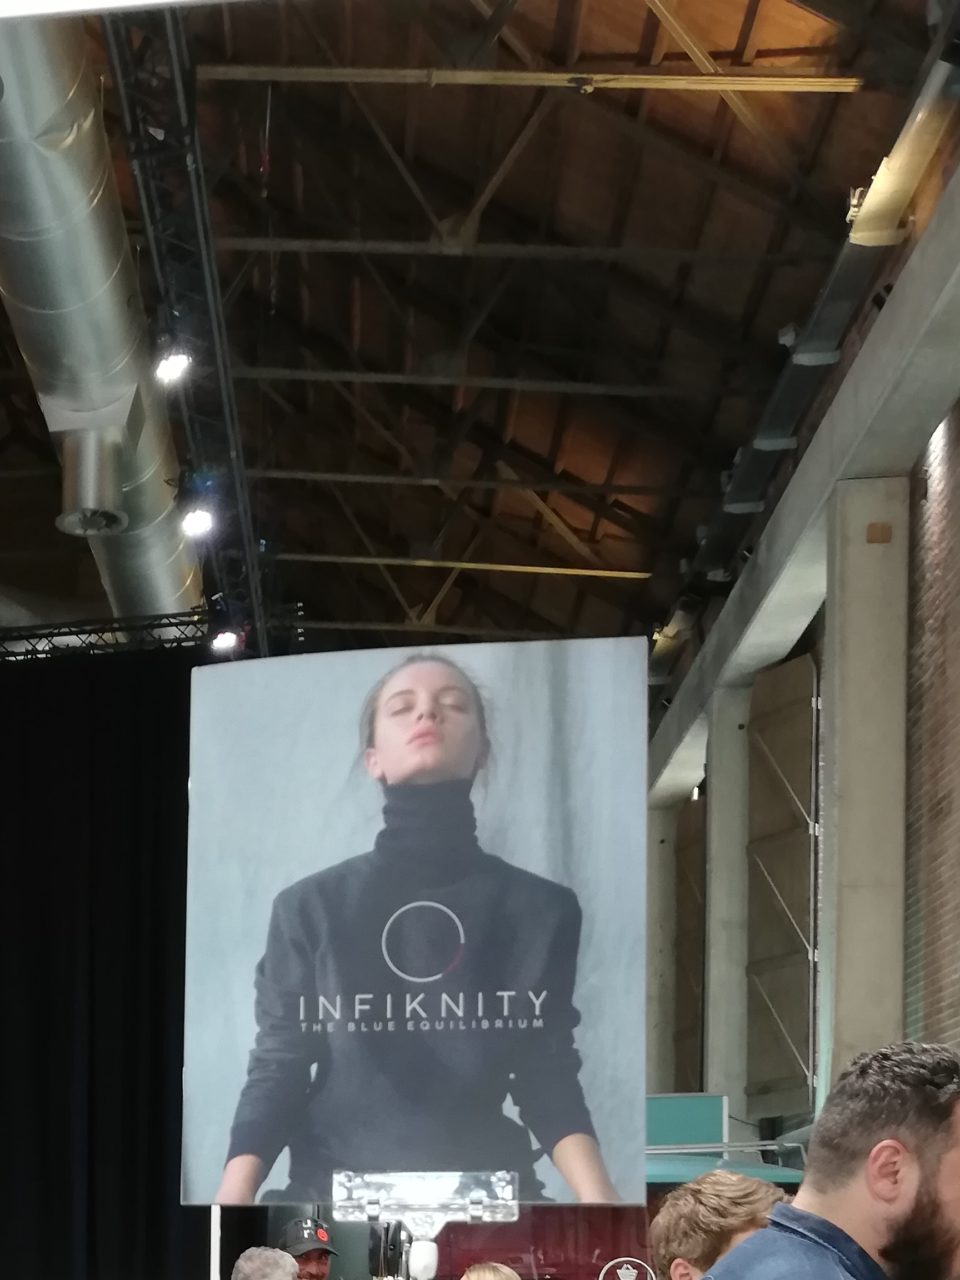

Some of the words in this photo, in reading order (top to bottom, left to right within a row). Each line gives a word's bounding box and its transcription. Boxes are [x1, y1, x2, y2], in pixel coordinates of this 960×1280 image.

[299, 990, 547, 1020] INFIKNITY
[300, 1022, 335, 1032] THE
[347, 1021, 395, 1032] BLUE
[407, 1019, 544, 1031] EQUILIBRIUM
